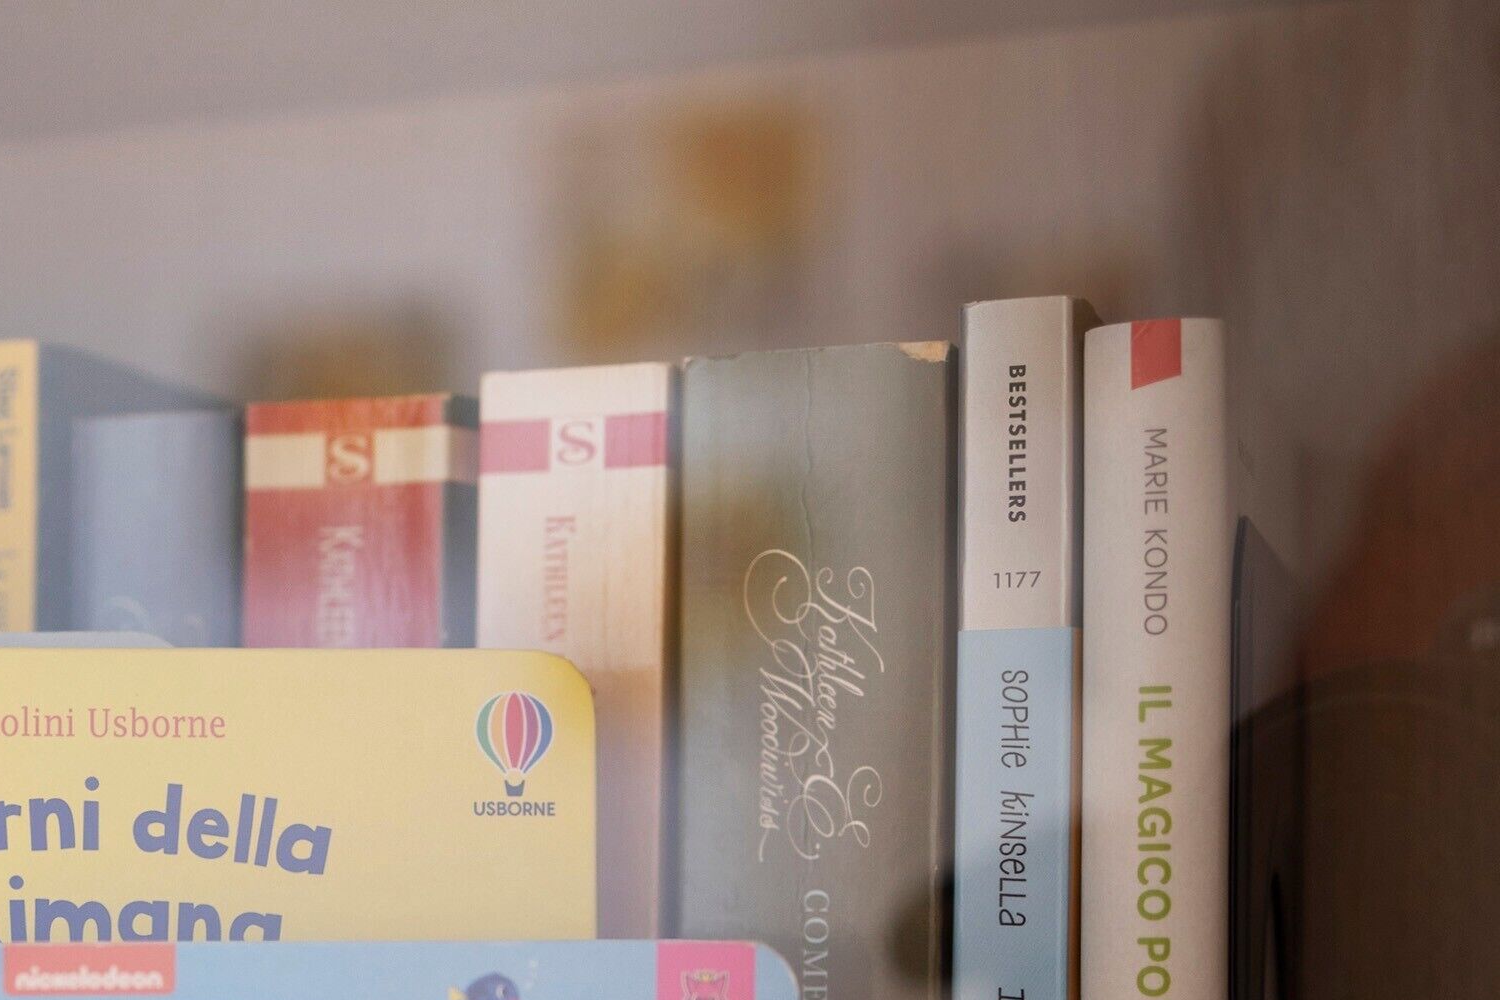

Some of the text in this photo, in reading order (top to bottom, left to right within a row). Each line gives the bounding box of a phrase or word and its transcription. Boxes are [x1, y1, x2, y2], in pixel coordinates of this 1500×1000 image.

[328, 435, 369, 483] S
[555, 420, 597, 466] S
[1008, 364, 1027, 523] BESTSELLERS
[1143, 427, 1168, 637] MARIE KONDO
[993, 570, 1042, 590] 1177
[797, 564, 885, 778] Kathleen
[87, 707, 228, 739] Usborne
[1137, 685, 1172, 724] IL
[132, 783, 333, 876] della
[473, 801, 556, 818] USBORNE
[1136, 737, 1172, 922] MAGICO
